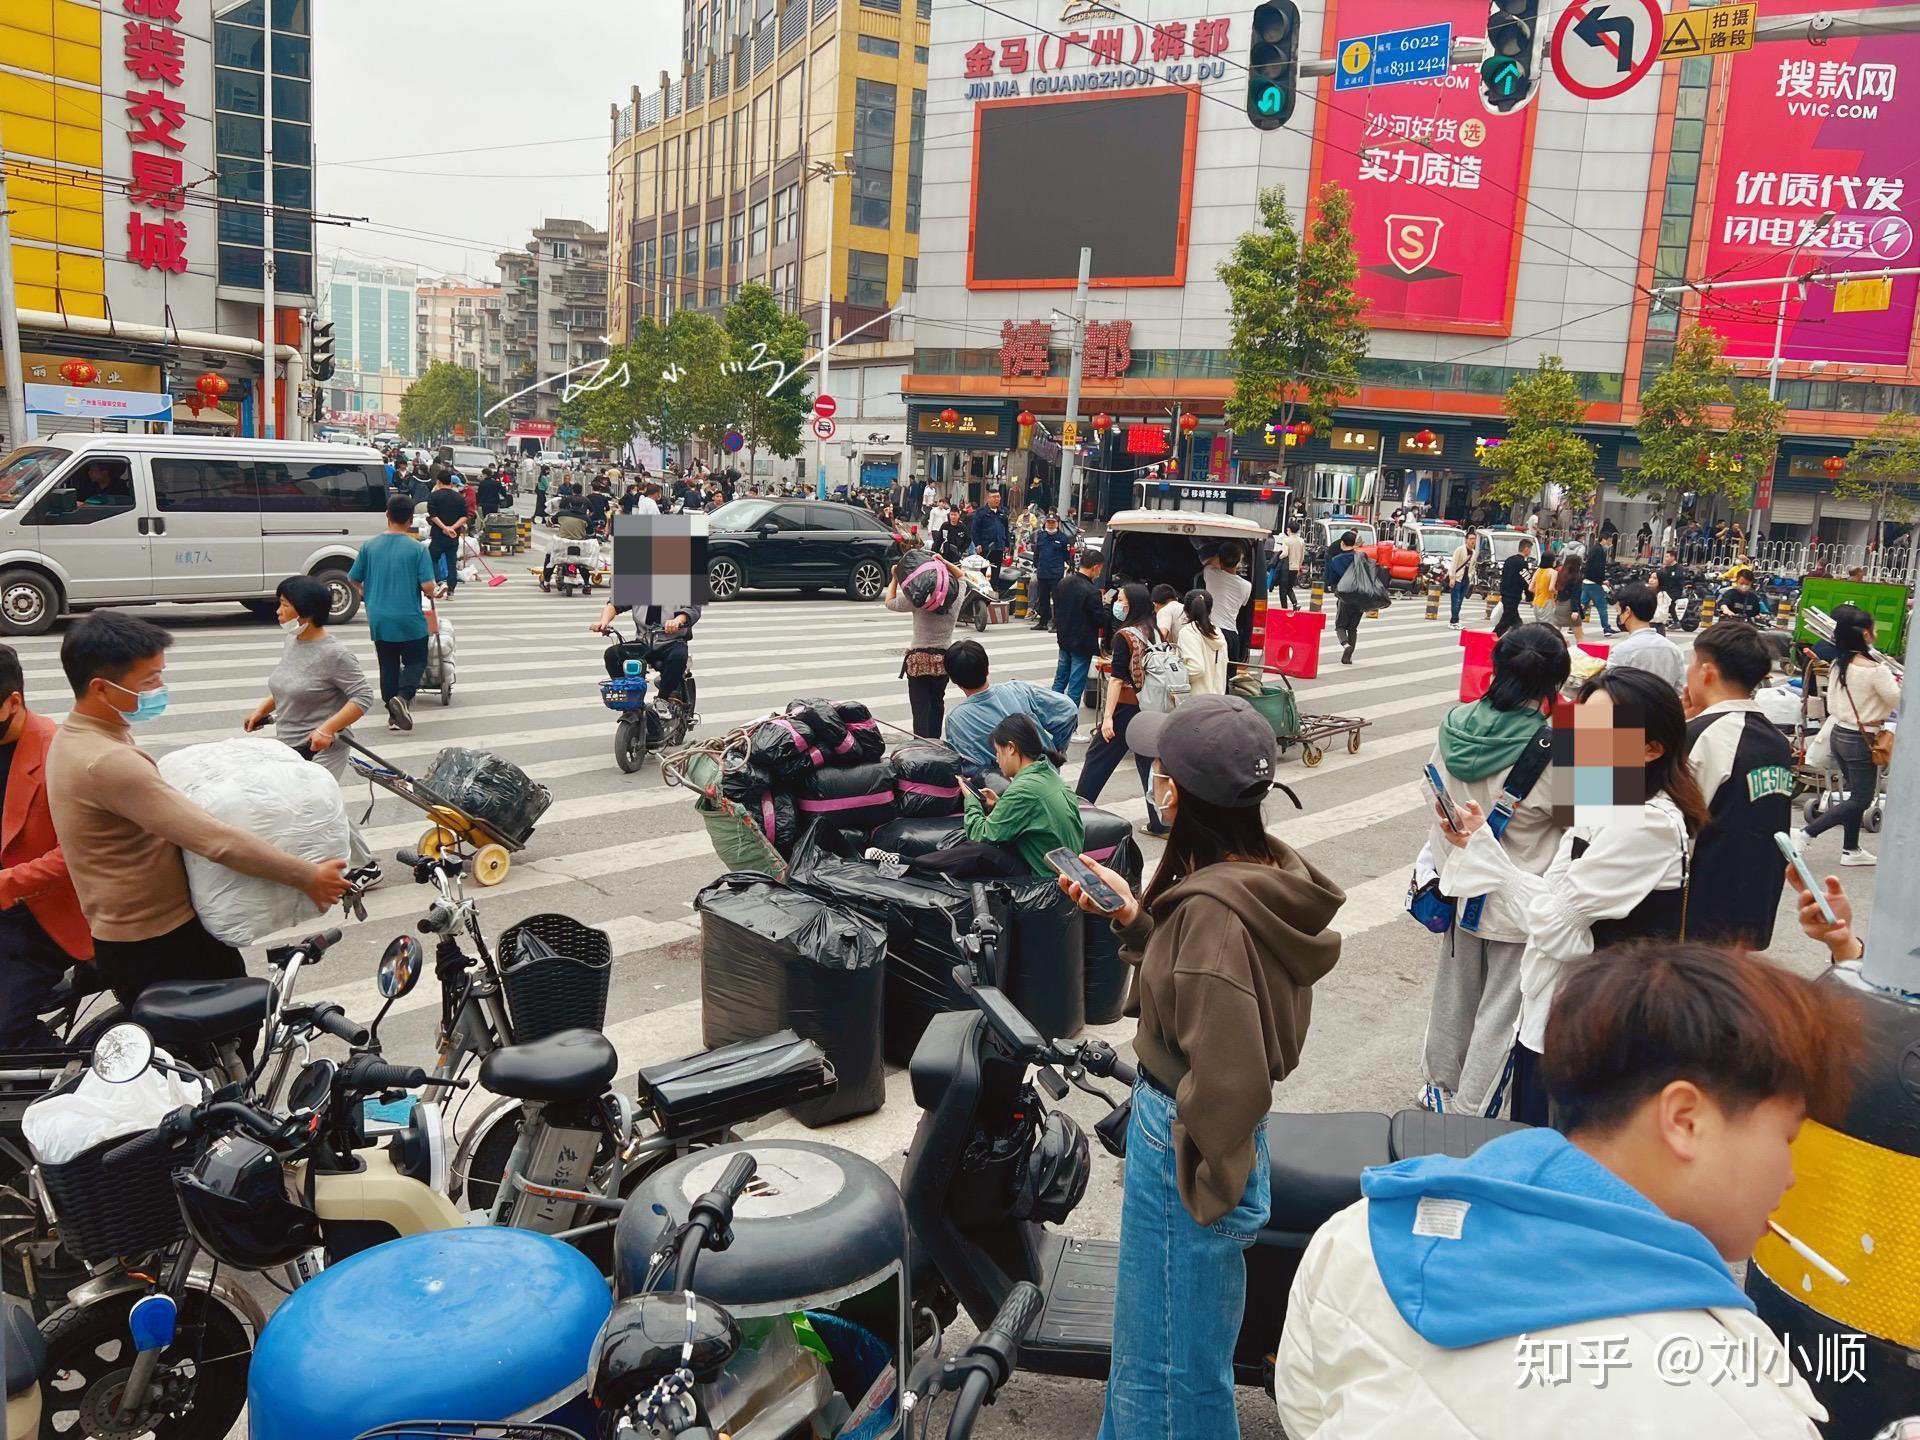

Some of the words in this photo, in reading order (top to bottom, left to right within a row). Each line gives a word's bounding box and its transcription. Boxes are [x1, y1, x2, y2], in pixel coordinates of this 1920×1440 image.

[1711, 8, 1750, 28] 拍摄
[1400, 35, 1439, 51] 6022
[1710, 30, 1747, 49] 路段
[964, 80, 990, 100] JIN
[993, 78, 1020, 98] MA
[1165, 64, 1191, 81] KU
[1197, 61, 1226, 79] DU
[1390, 61, 1415, 76] 8311
[1417, 56, 1446, 72] 2424
[1775, 58, 1897, 102] 搜款网
[1787, 101, 1879, 119] VVIC.COM
[1364, 112, 1458, 144] 沙河好货
[1462, 121, 1482, 143] 选
[1357, 147, 1483, 190] 实力质造
[1735, 171, 1905, 212] 优质代发
[1723, 215, 1866, 250] 闪电发货
